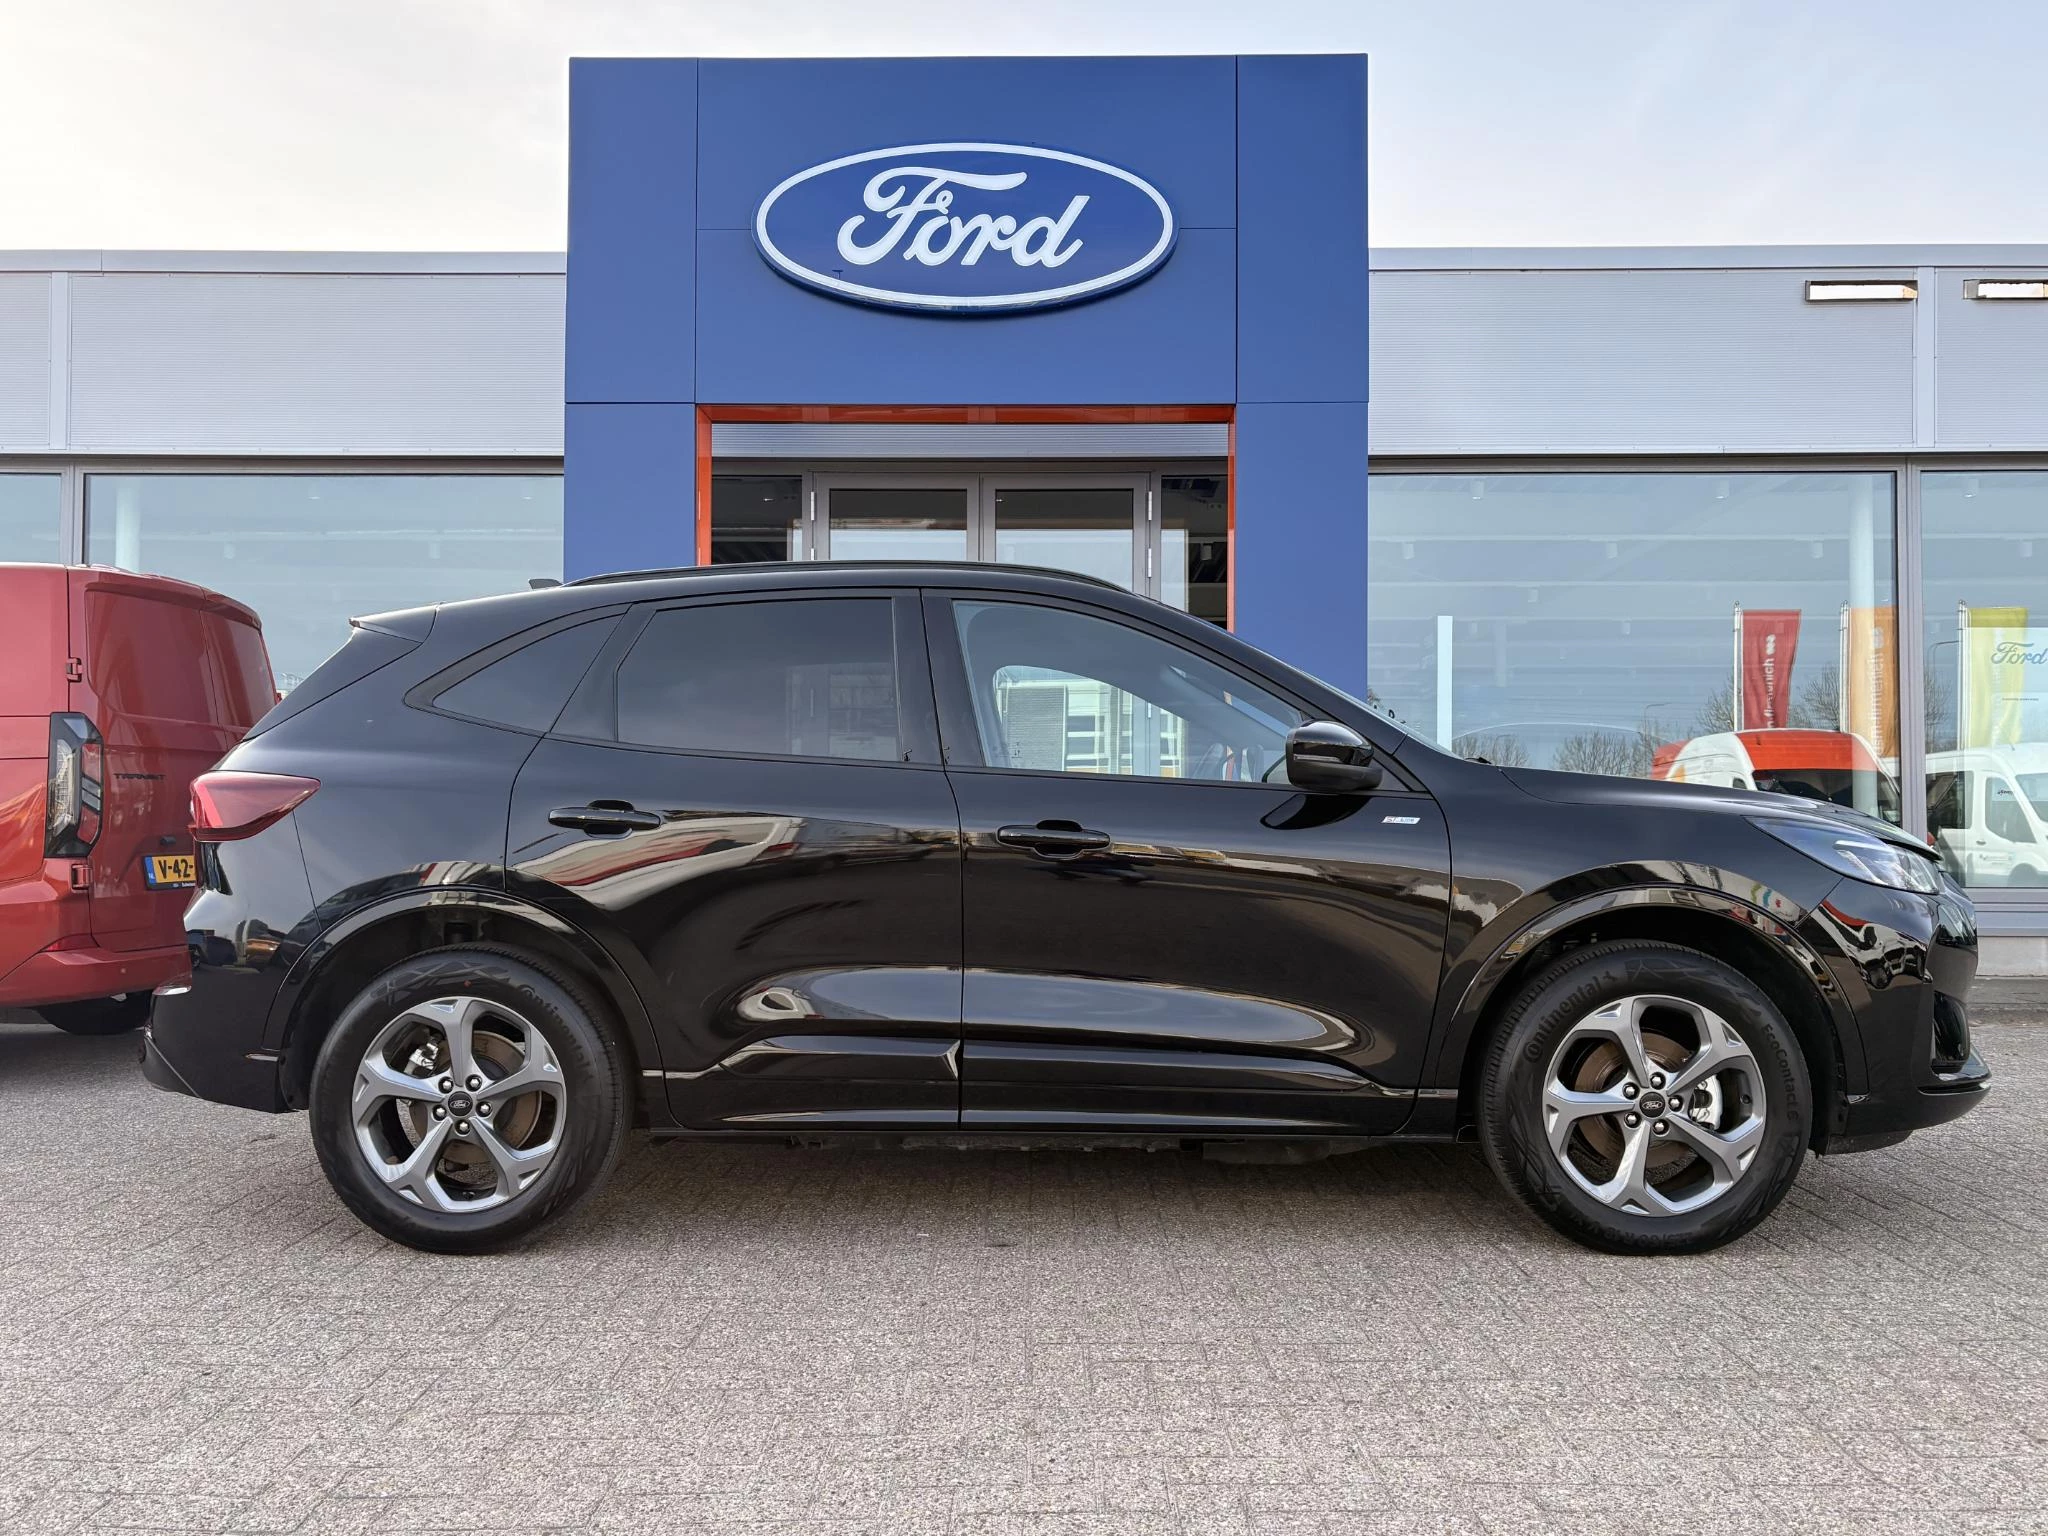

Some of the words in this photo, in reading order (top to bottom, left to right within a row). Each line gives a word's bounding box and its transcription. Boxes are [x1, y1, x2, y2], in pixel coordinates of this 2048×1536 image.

[837, 166, 1090, 268] Ford
[1991, 641, 2048, 664] Ford
[158, 859, 194, 879] V-42-
[1523, 975, 1601, 1062] Continental
[1762, 1023, 1799, 1109] EcoContact
